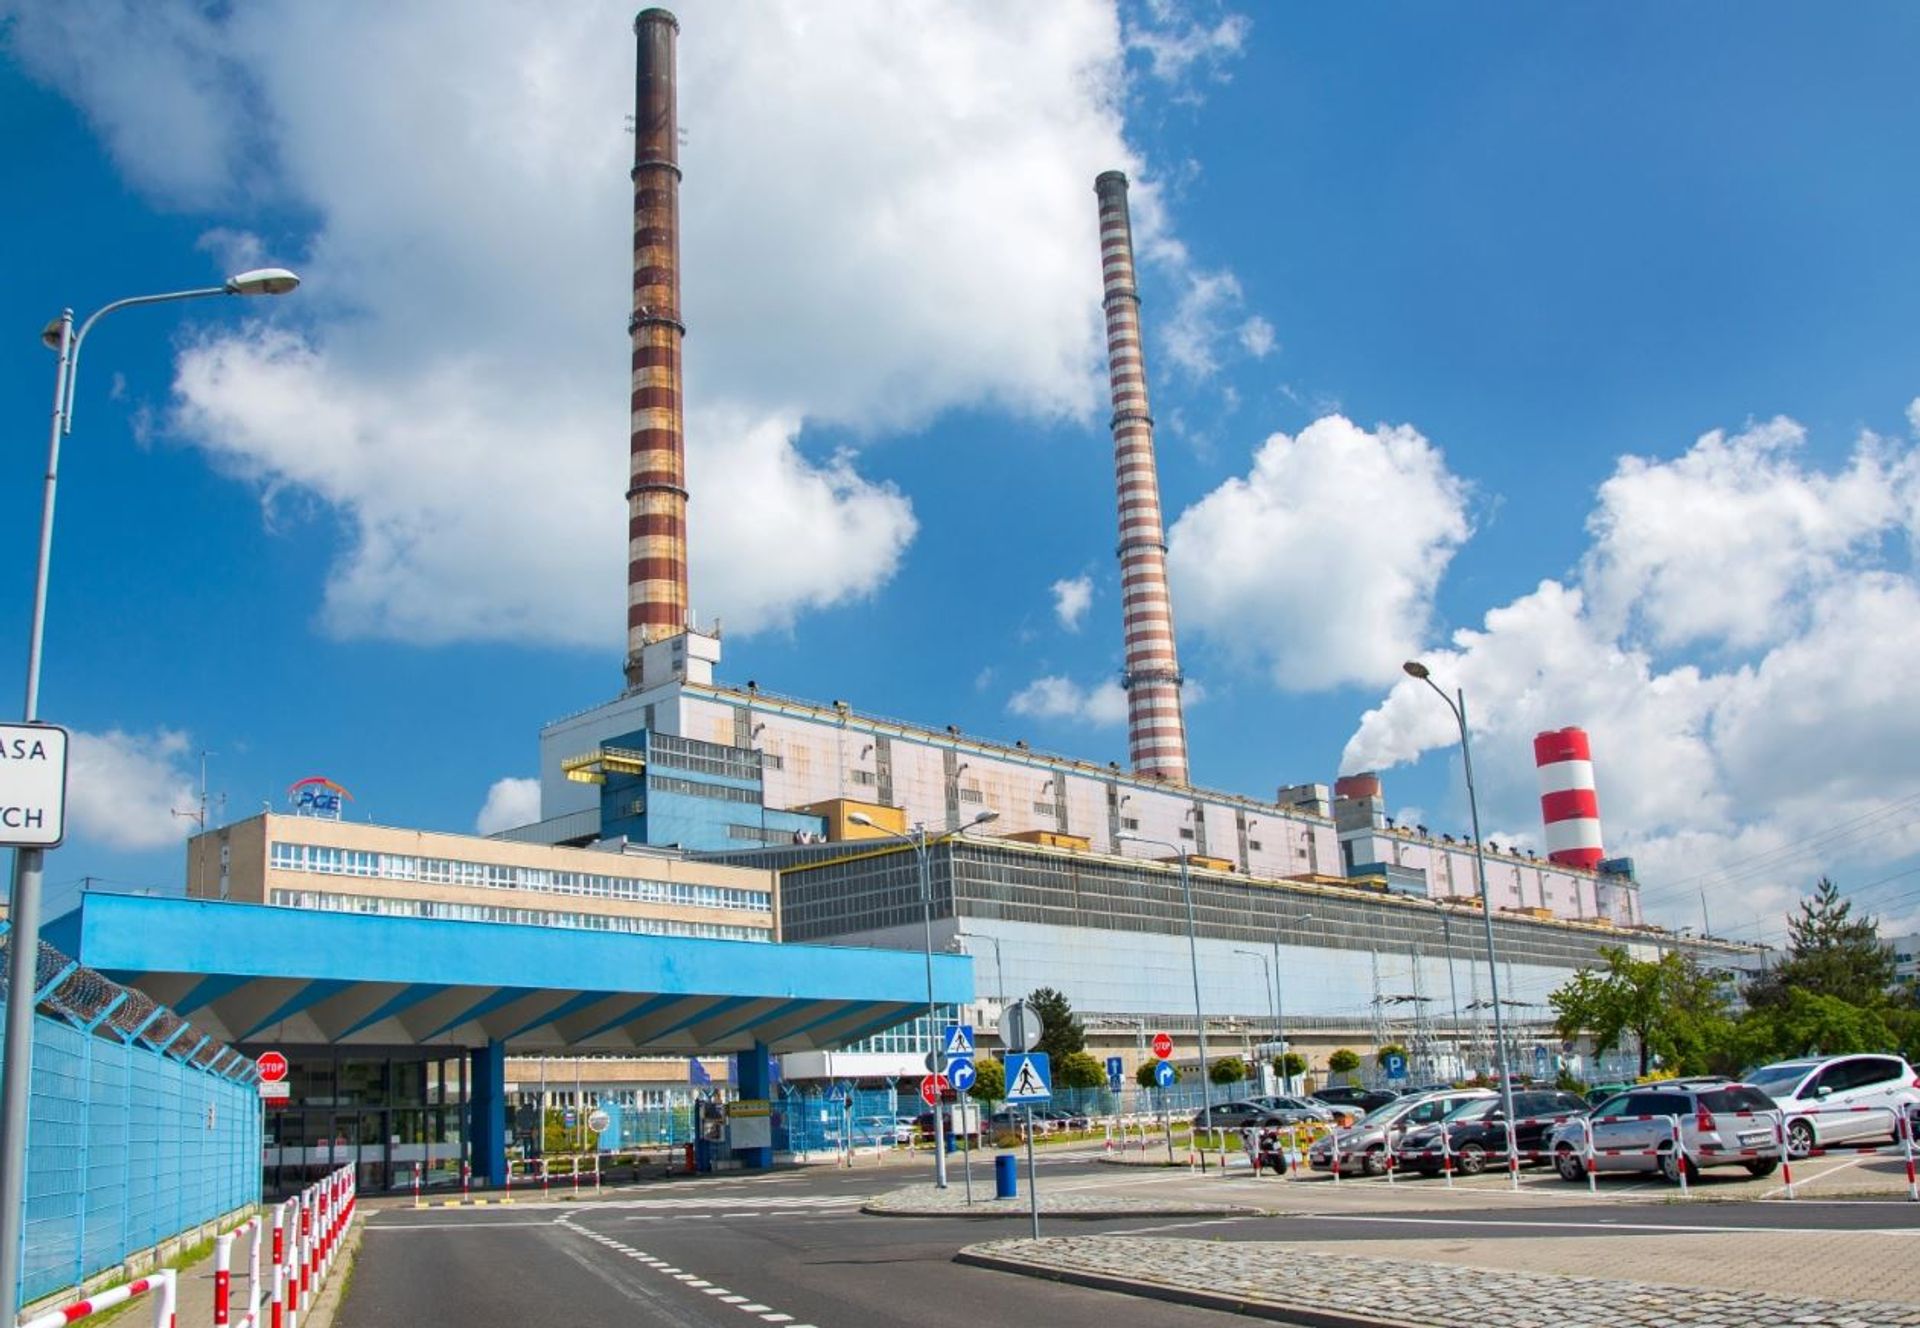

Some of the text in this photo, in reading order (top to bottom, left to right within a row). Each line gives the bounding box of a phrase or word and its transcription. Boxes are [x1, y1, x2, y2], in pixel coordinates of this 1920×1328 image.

[297, 791, 338, 810] PGE
[0, 807, 42, 829] CH
[1155, 1041, 1170, 1051] STOP
[259, 1062, 284, 1075] STOP
[1390, 1056, 1401, 1072] P
